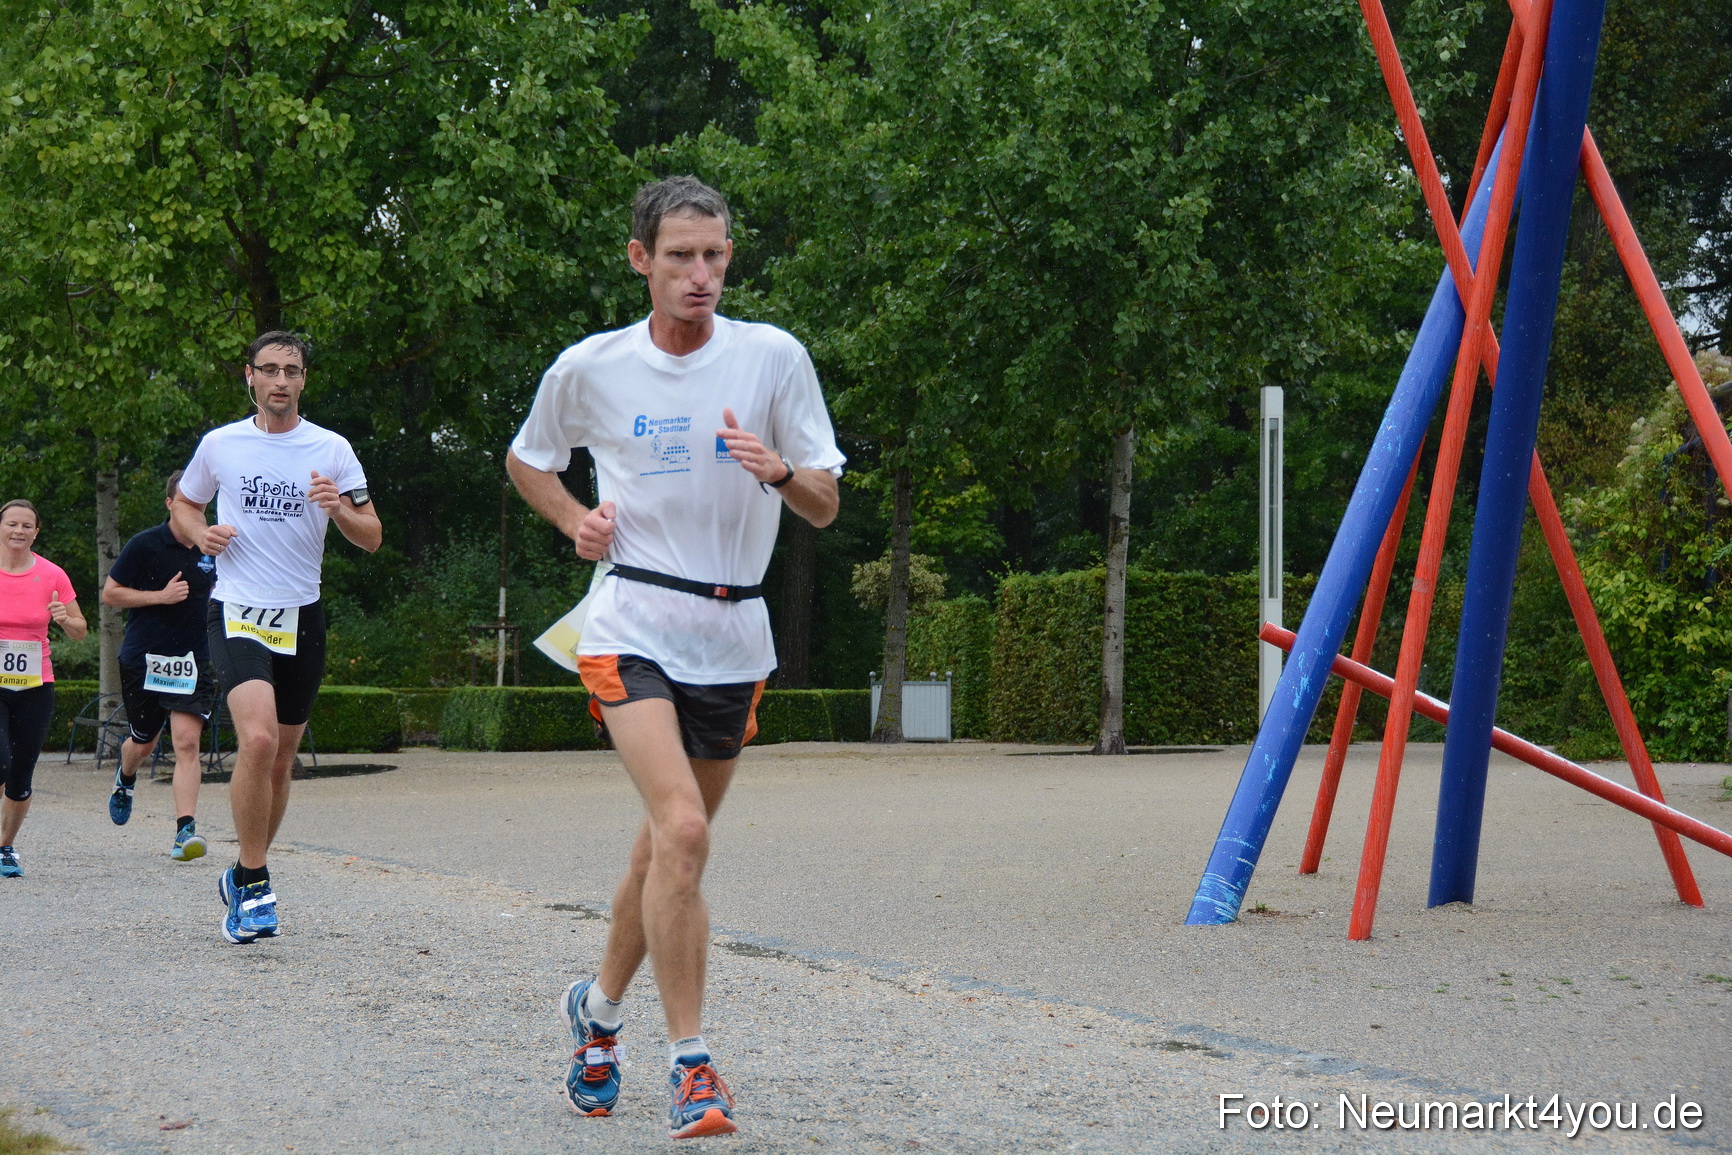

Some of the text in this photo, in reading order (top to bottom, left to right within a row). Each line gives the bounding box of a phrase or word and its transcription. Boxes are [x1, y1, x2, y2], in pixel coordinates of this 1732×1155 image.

[634, 415, 691, 437] 6. Neumarkter
[658, 424, 691, 434] Stadtlauf
[241, 475, 299, 498] Sport
[244, 496, 302, 511] Müller
[239, 604, 285, 628] 272
[4, 653, 27, 672] 86
[152, 660, 194, 677] 2499
[0, 676, 28, 685] Tamara
[153, 678, 189, 687] Maximilian
